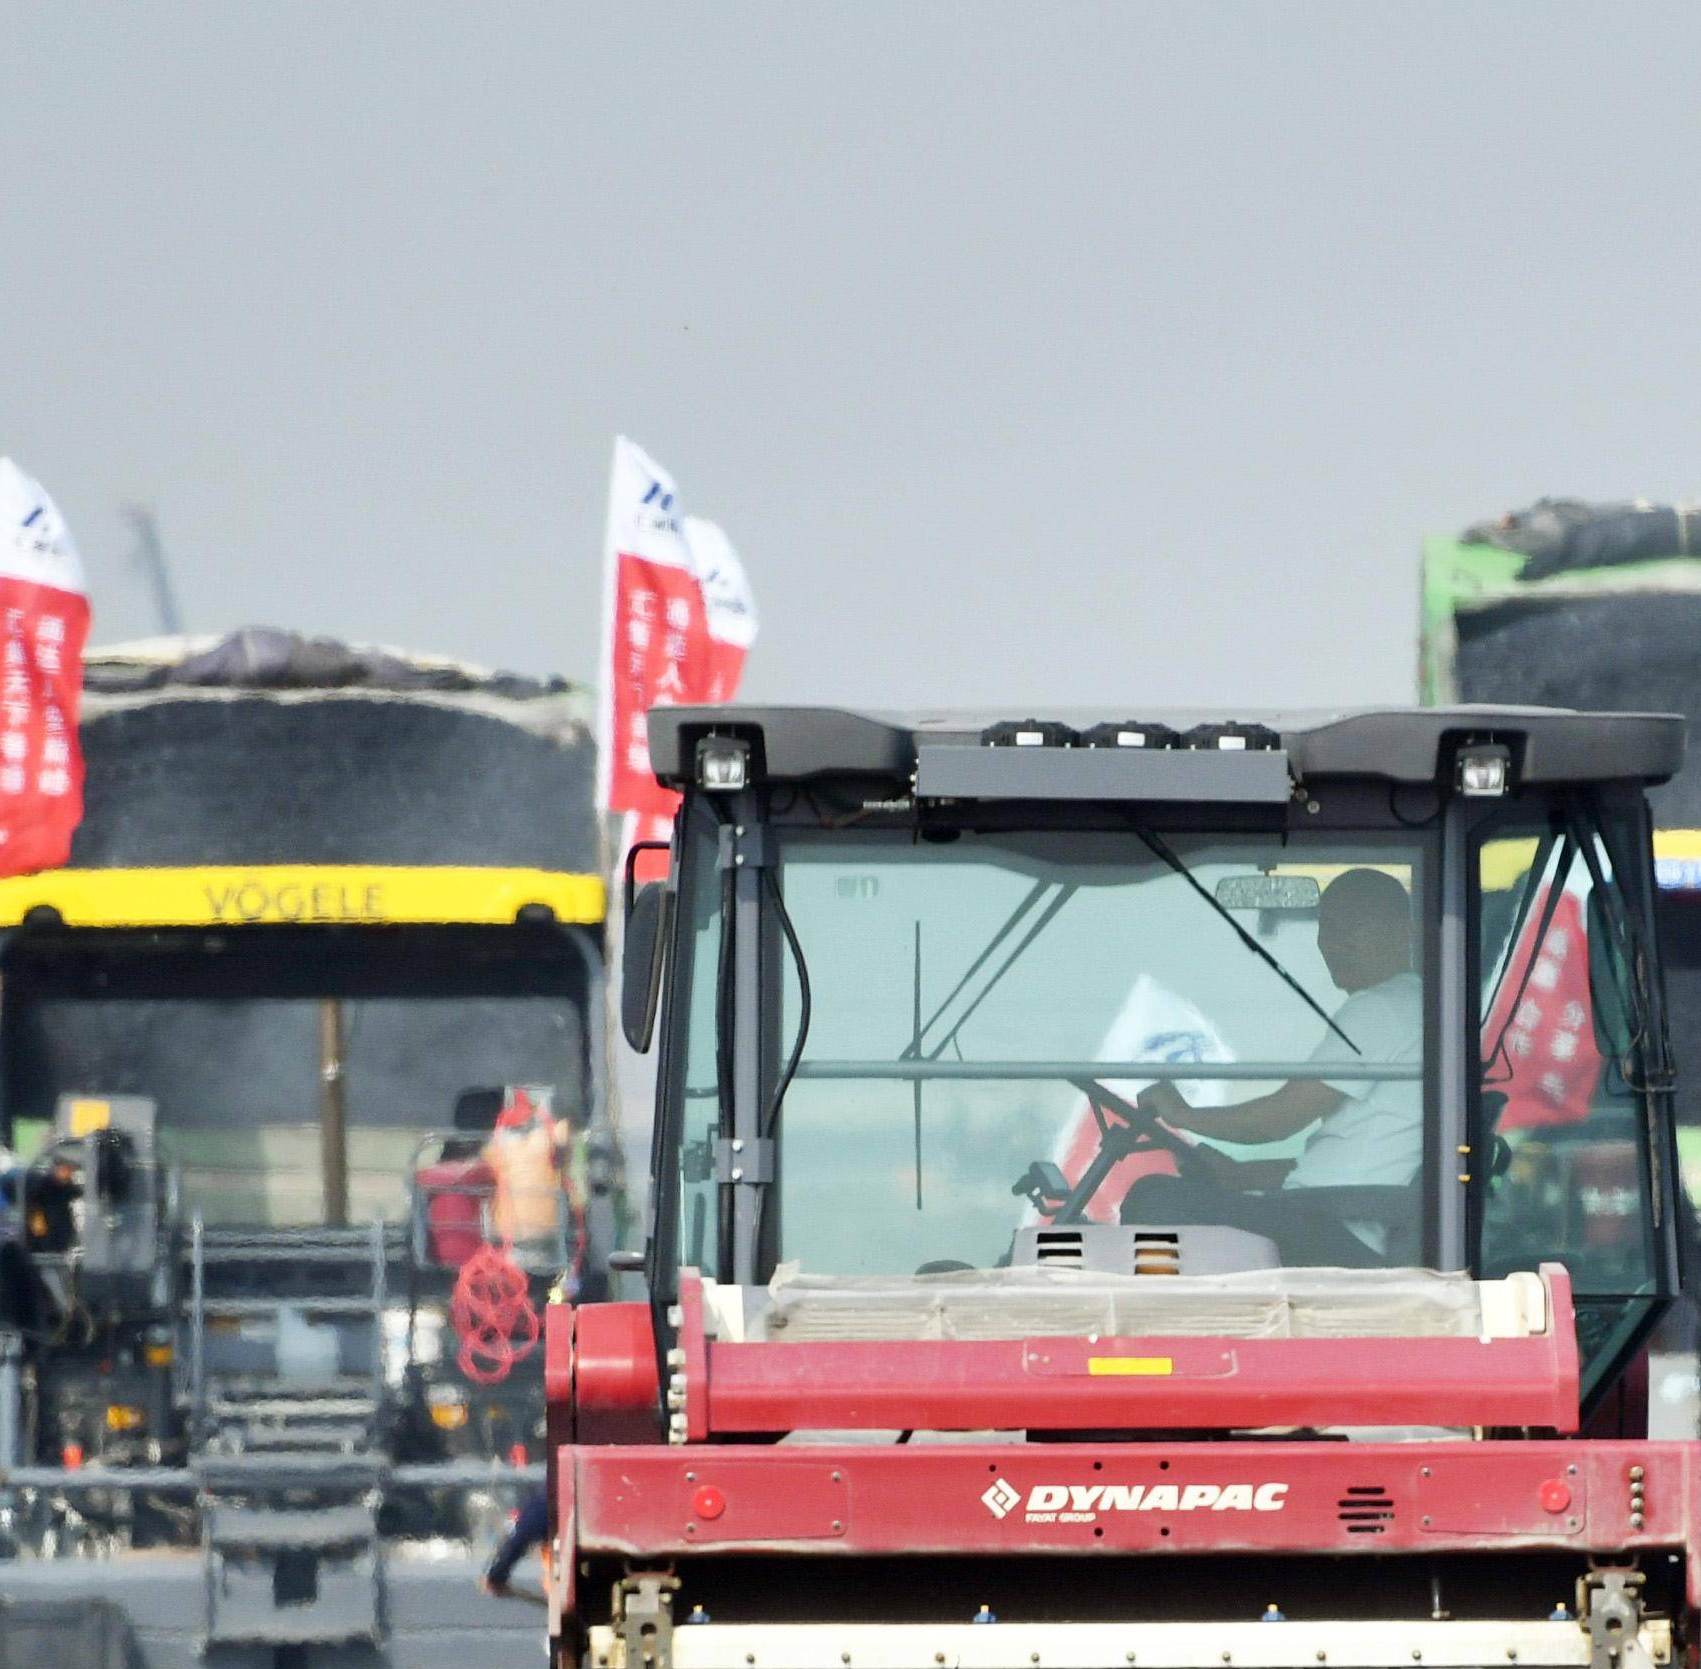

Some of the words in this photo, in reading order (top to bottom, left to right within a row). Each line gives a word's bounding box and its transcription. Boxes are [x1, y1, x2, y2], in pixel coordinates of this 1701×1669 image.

[1025, 1482, 1289, 1511] DYNAPAC
[1024, 1512, 1058, 1523] FAYAT
[1059, 1512, 1096, 1523] GROUP
